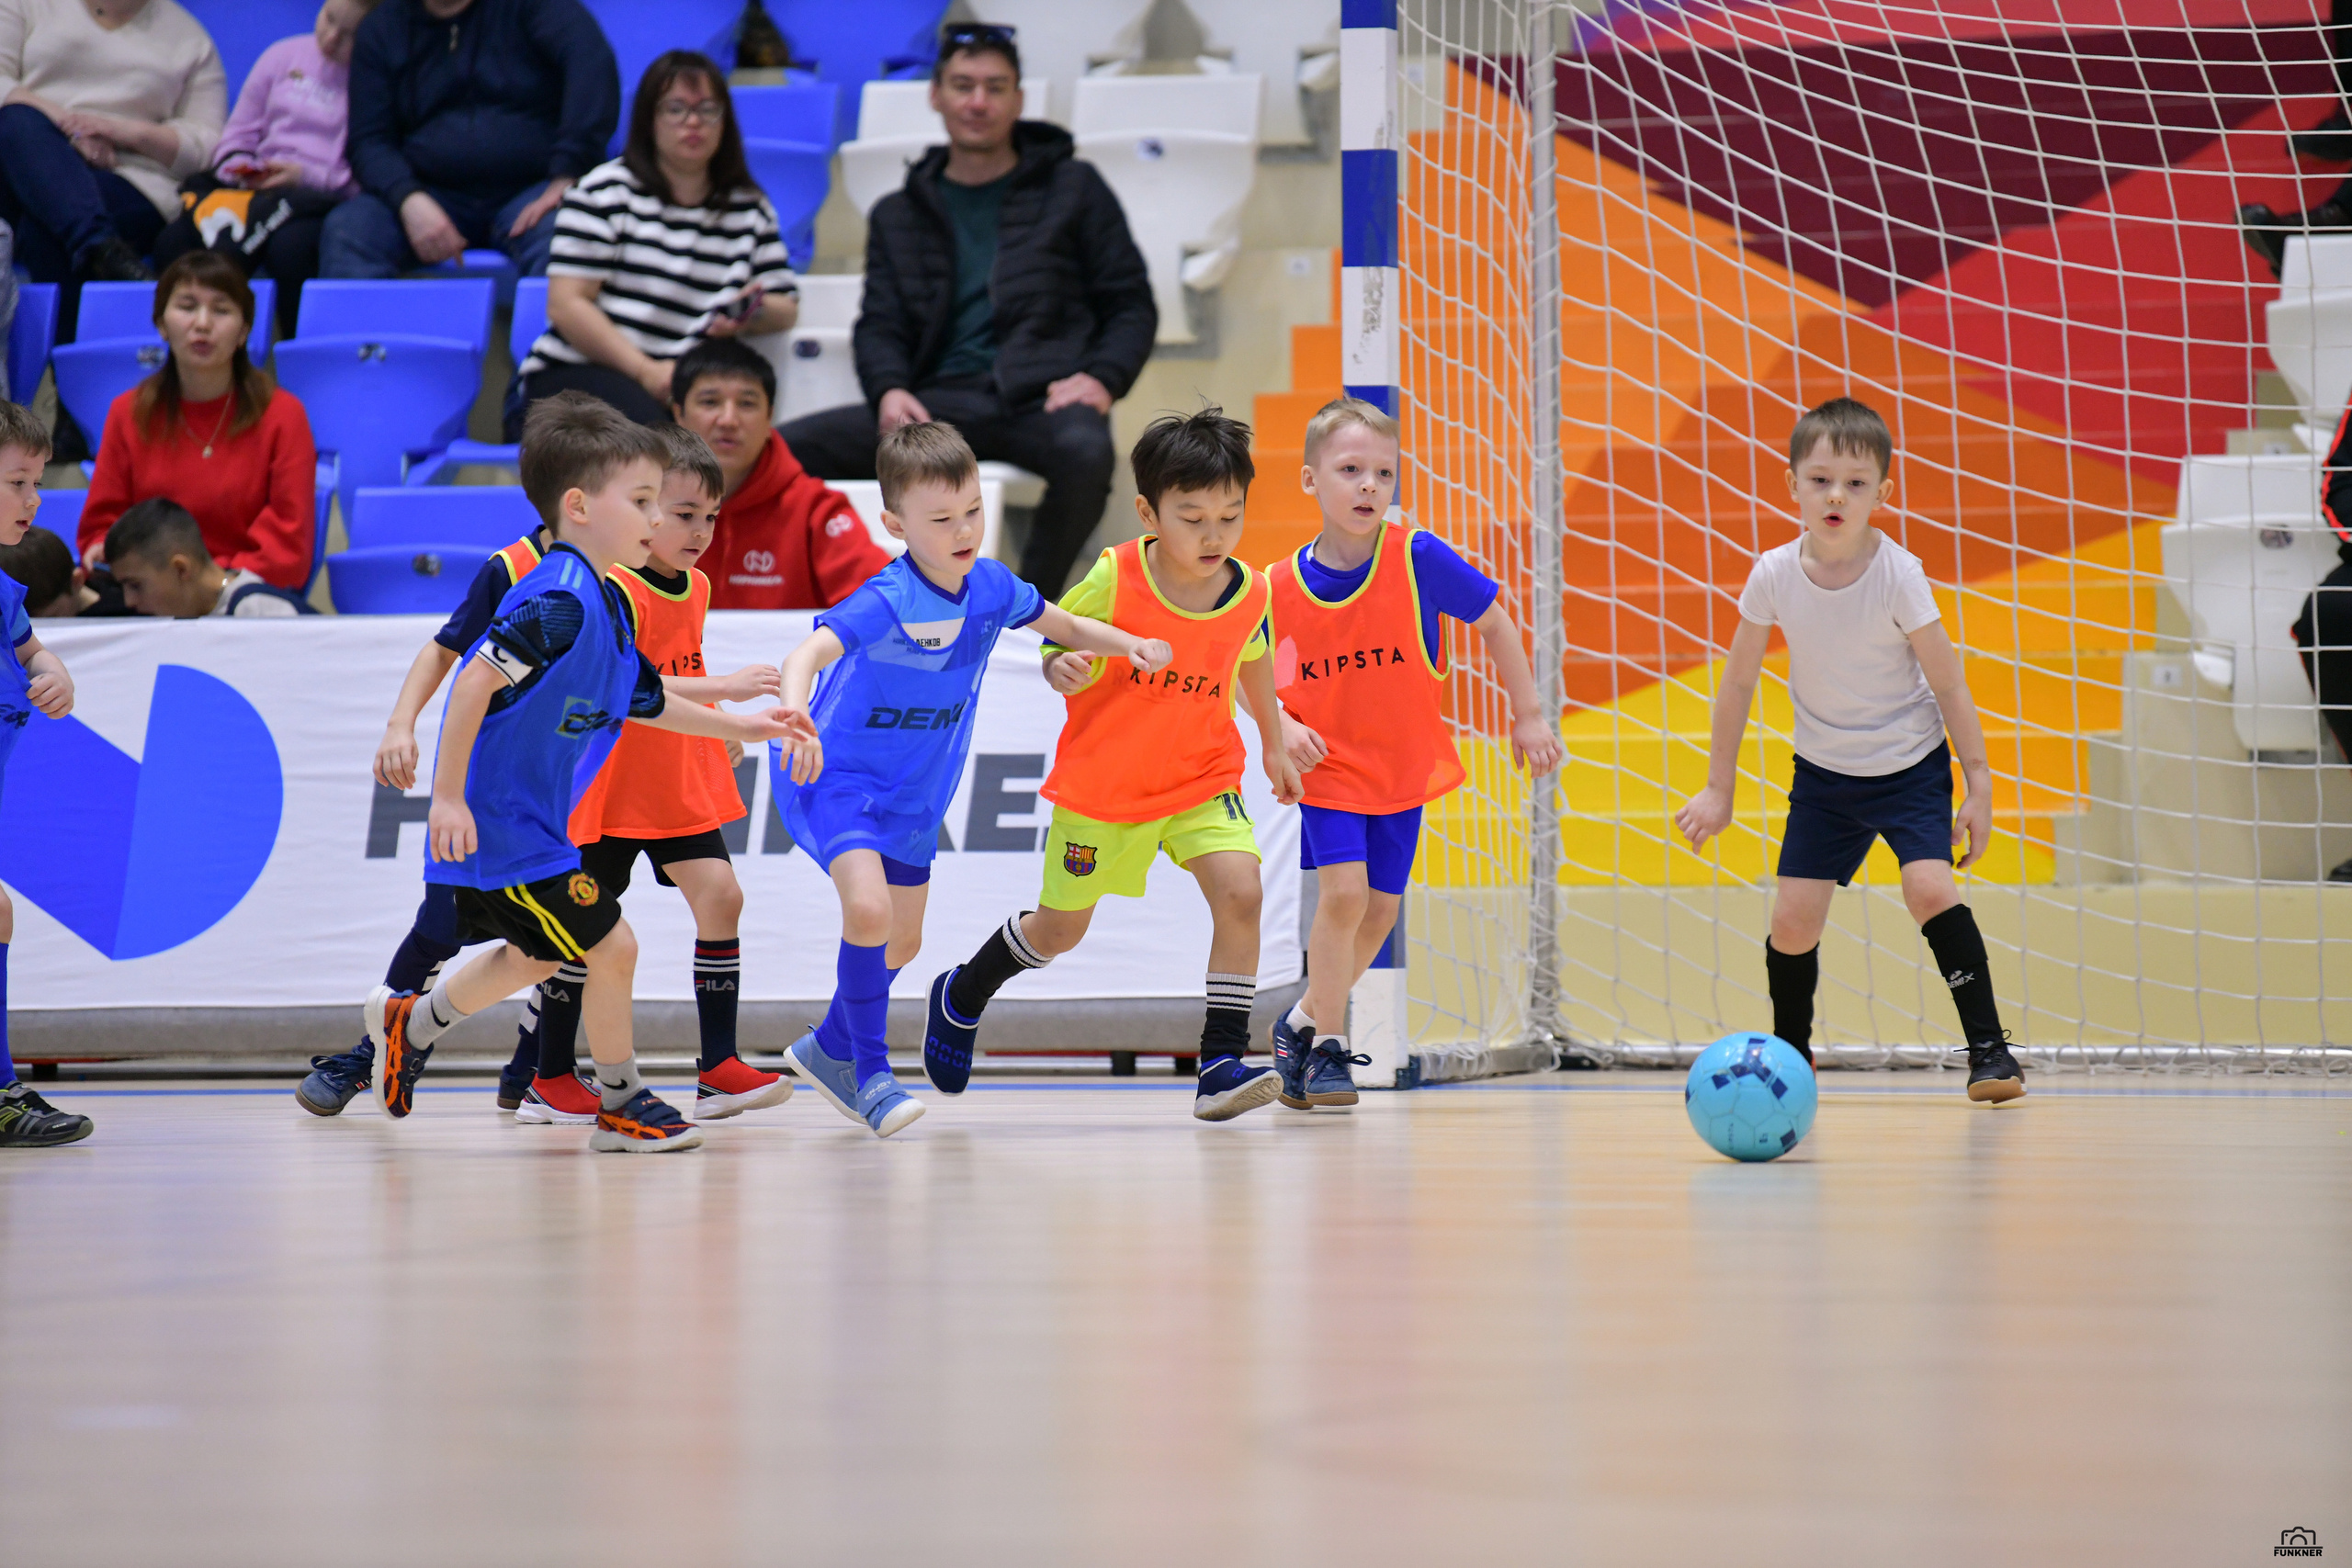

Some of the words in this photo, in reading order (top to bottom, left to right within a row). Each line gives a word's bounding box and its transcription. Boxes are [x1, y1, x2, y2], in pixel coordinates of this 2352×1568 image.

[1301, 647, 1406, 681] KIPSTA
[1129, 667, 1221, 698] KIPSTA
[695, 979, 735, 992] FILA
